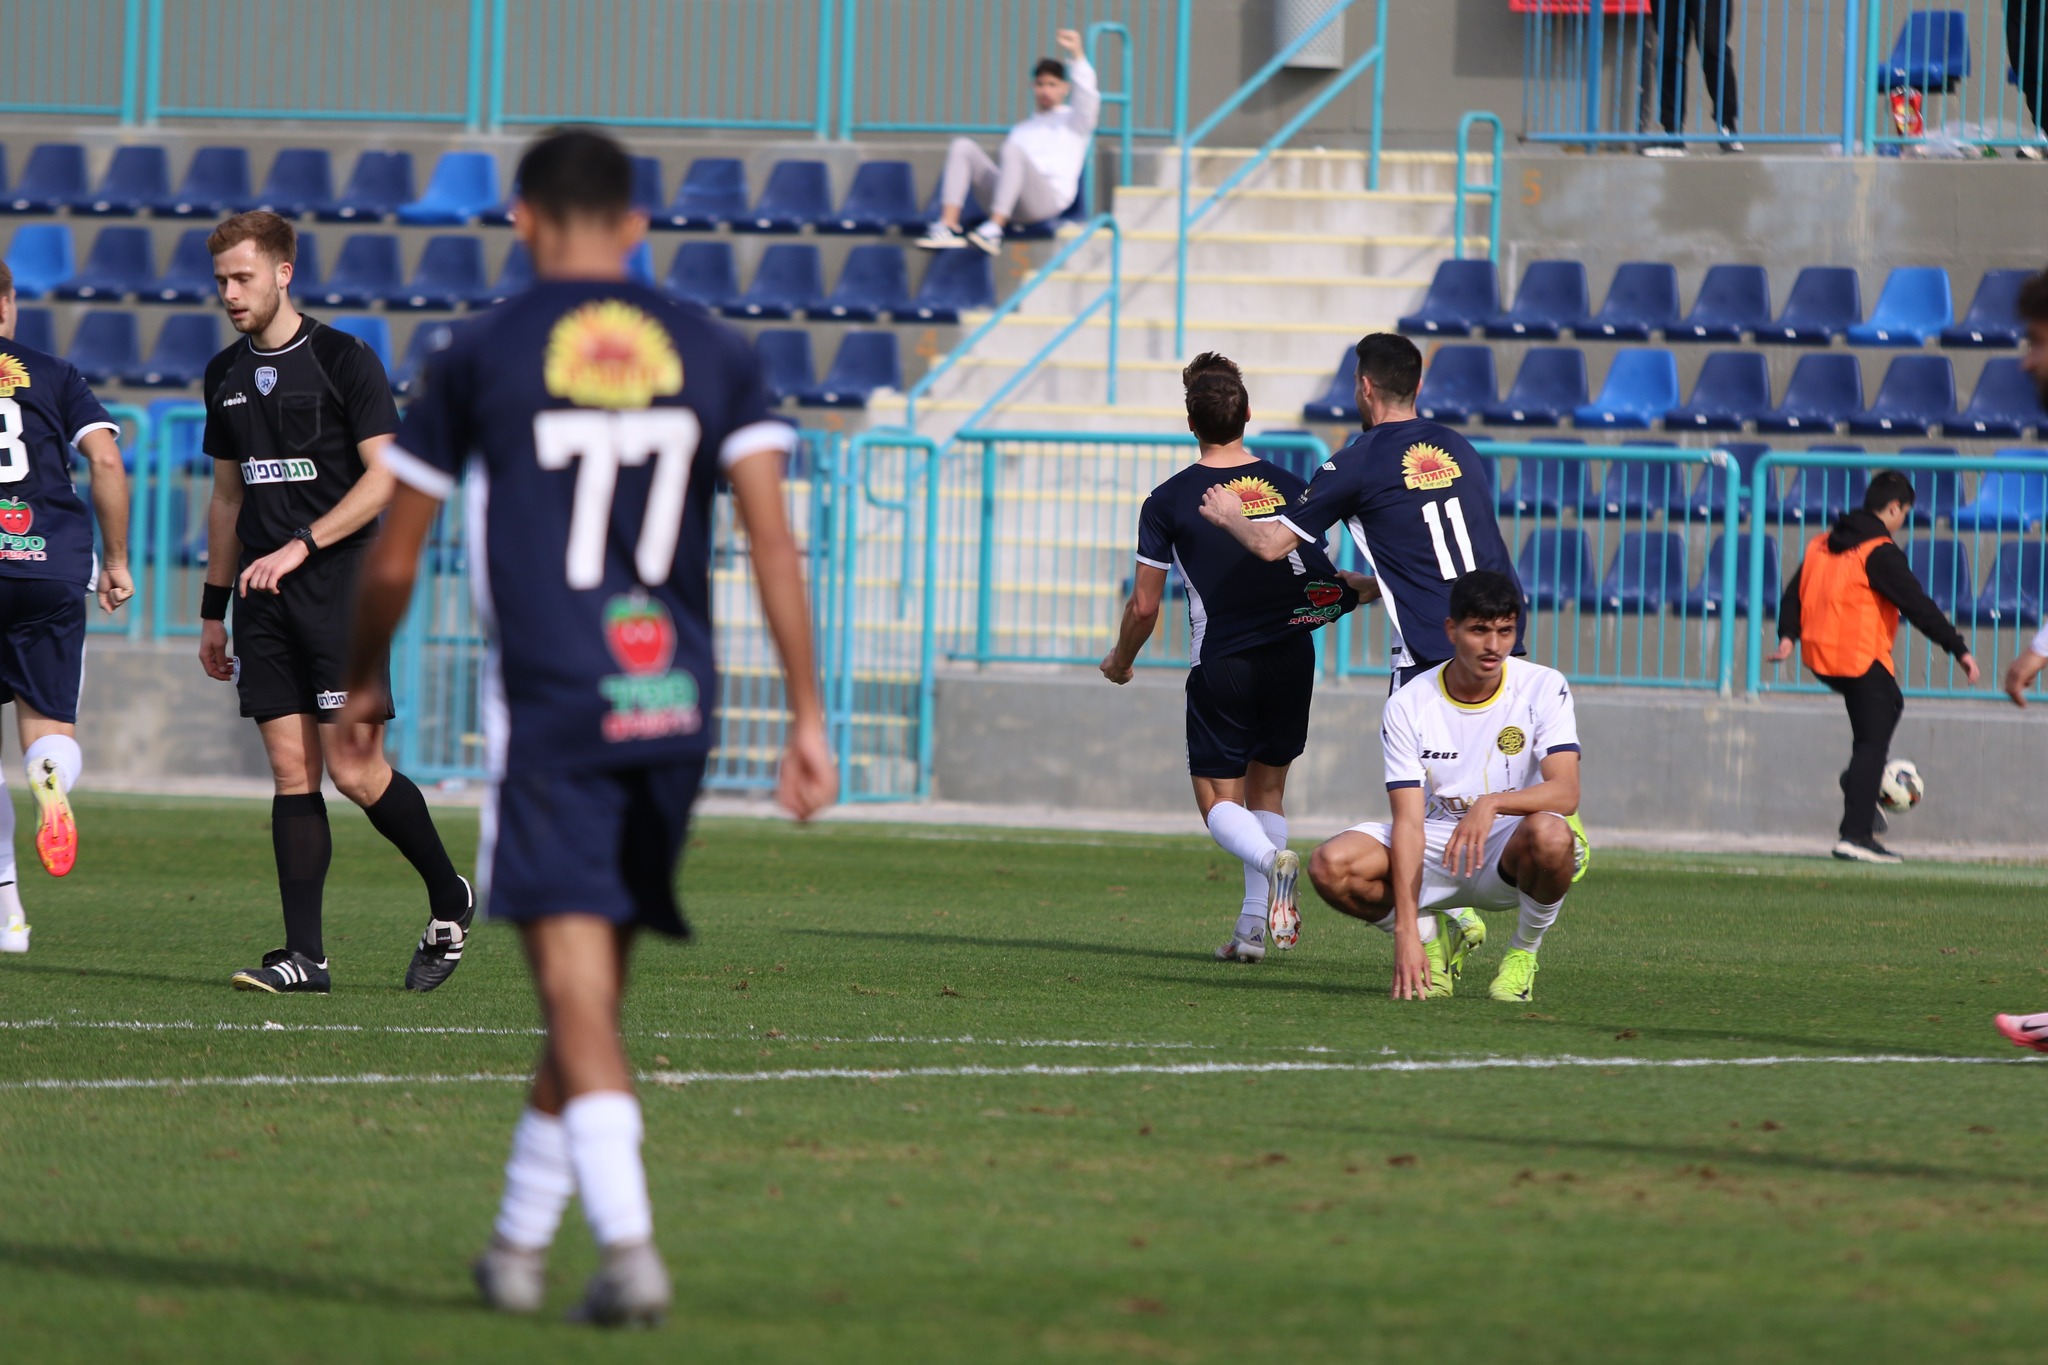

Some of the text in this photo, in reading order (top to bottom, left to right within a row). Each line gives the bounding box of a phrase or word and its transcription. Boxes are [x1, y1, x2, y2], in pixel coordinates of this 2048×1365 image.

[1521, 169, 1543, 206] 5
[1411, 467, 1456, 486] החמניה
[533, 406, 702, 590] 77
[1243, 496, 1280, 511] החמנ
[1421, 497, 1476, 580] 11
[1421, 750, 1459, 760] Zeus
